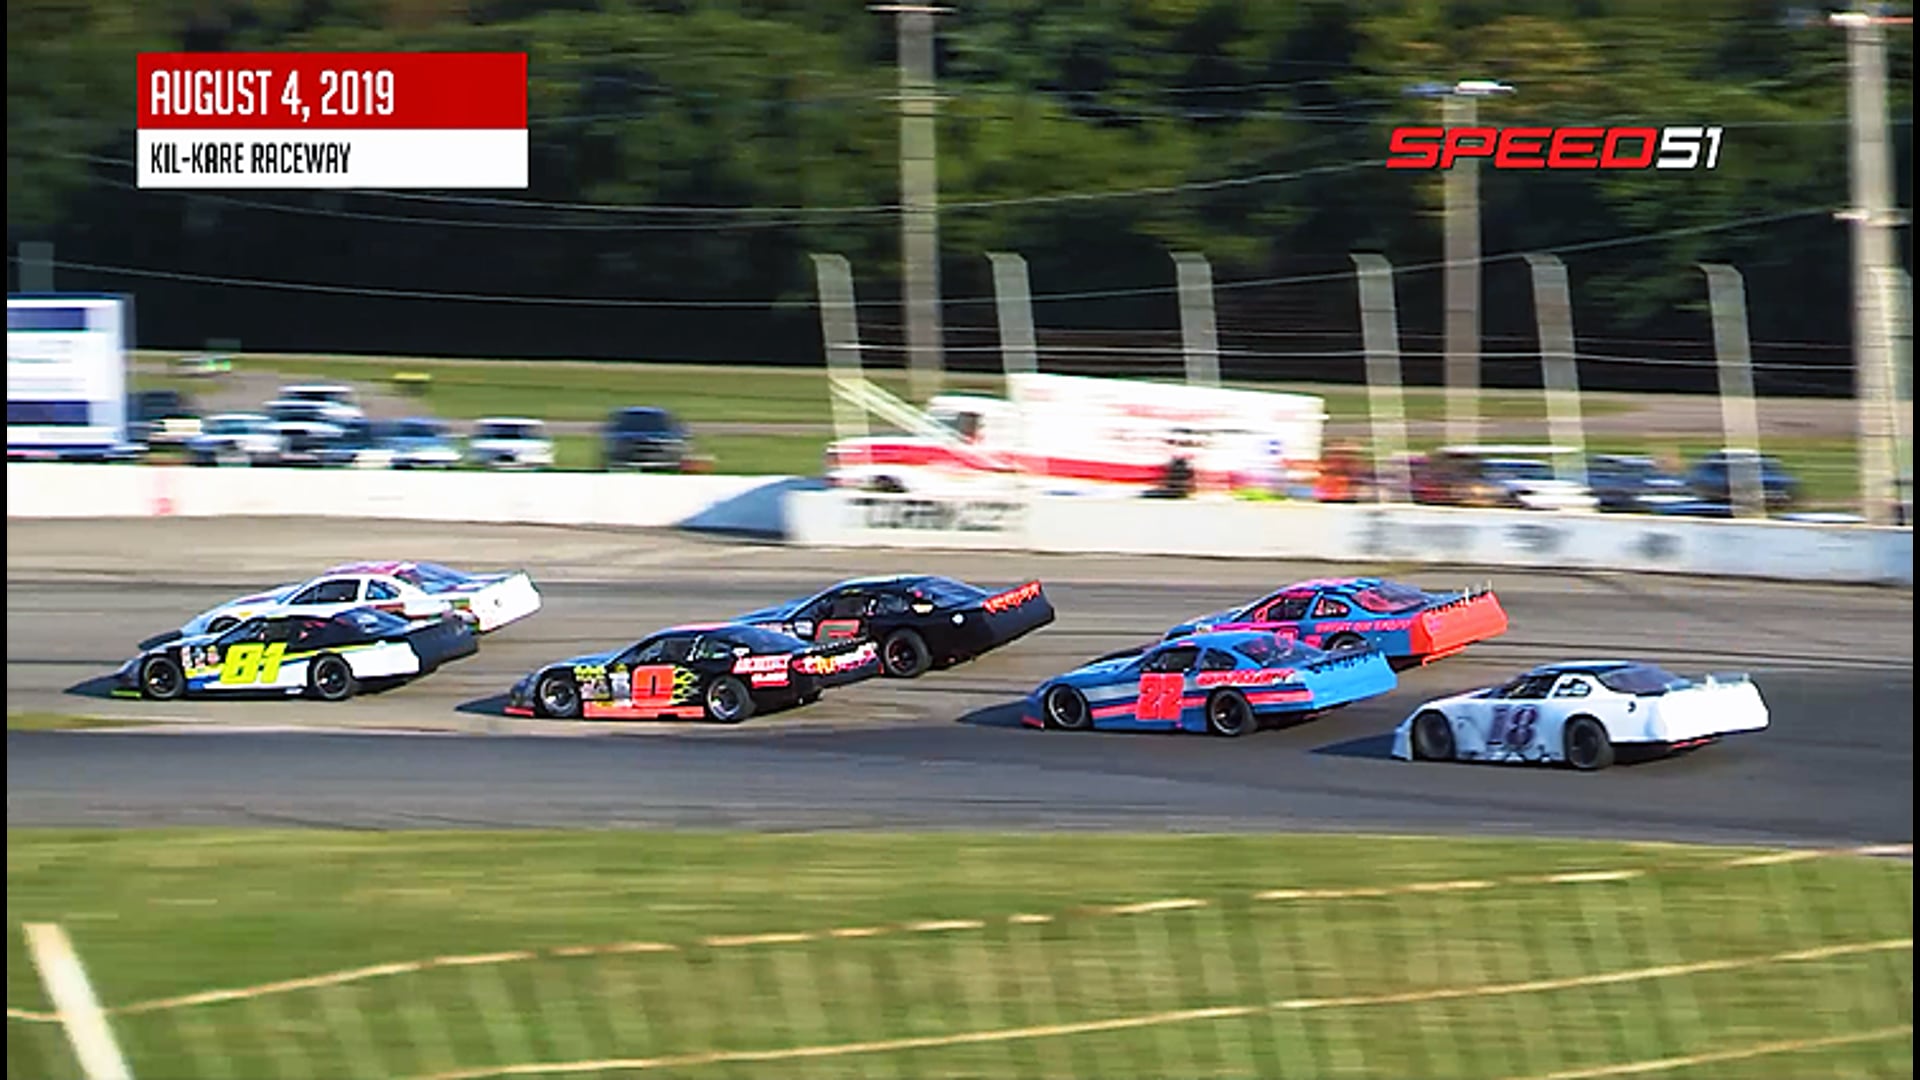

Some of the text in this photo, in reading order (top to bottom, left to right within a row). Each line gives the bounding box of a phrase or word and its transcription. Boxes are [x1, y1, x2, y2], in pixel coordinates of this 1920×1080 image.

[221, 643, 287, 684] 81
[1136, 672, 1184, 720] 22
[1486, 704, 1540, 749] 18
